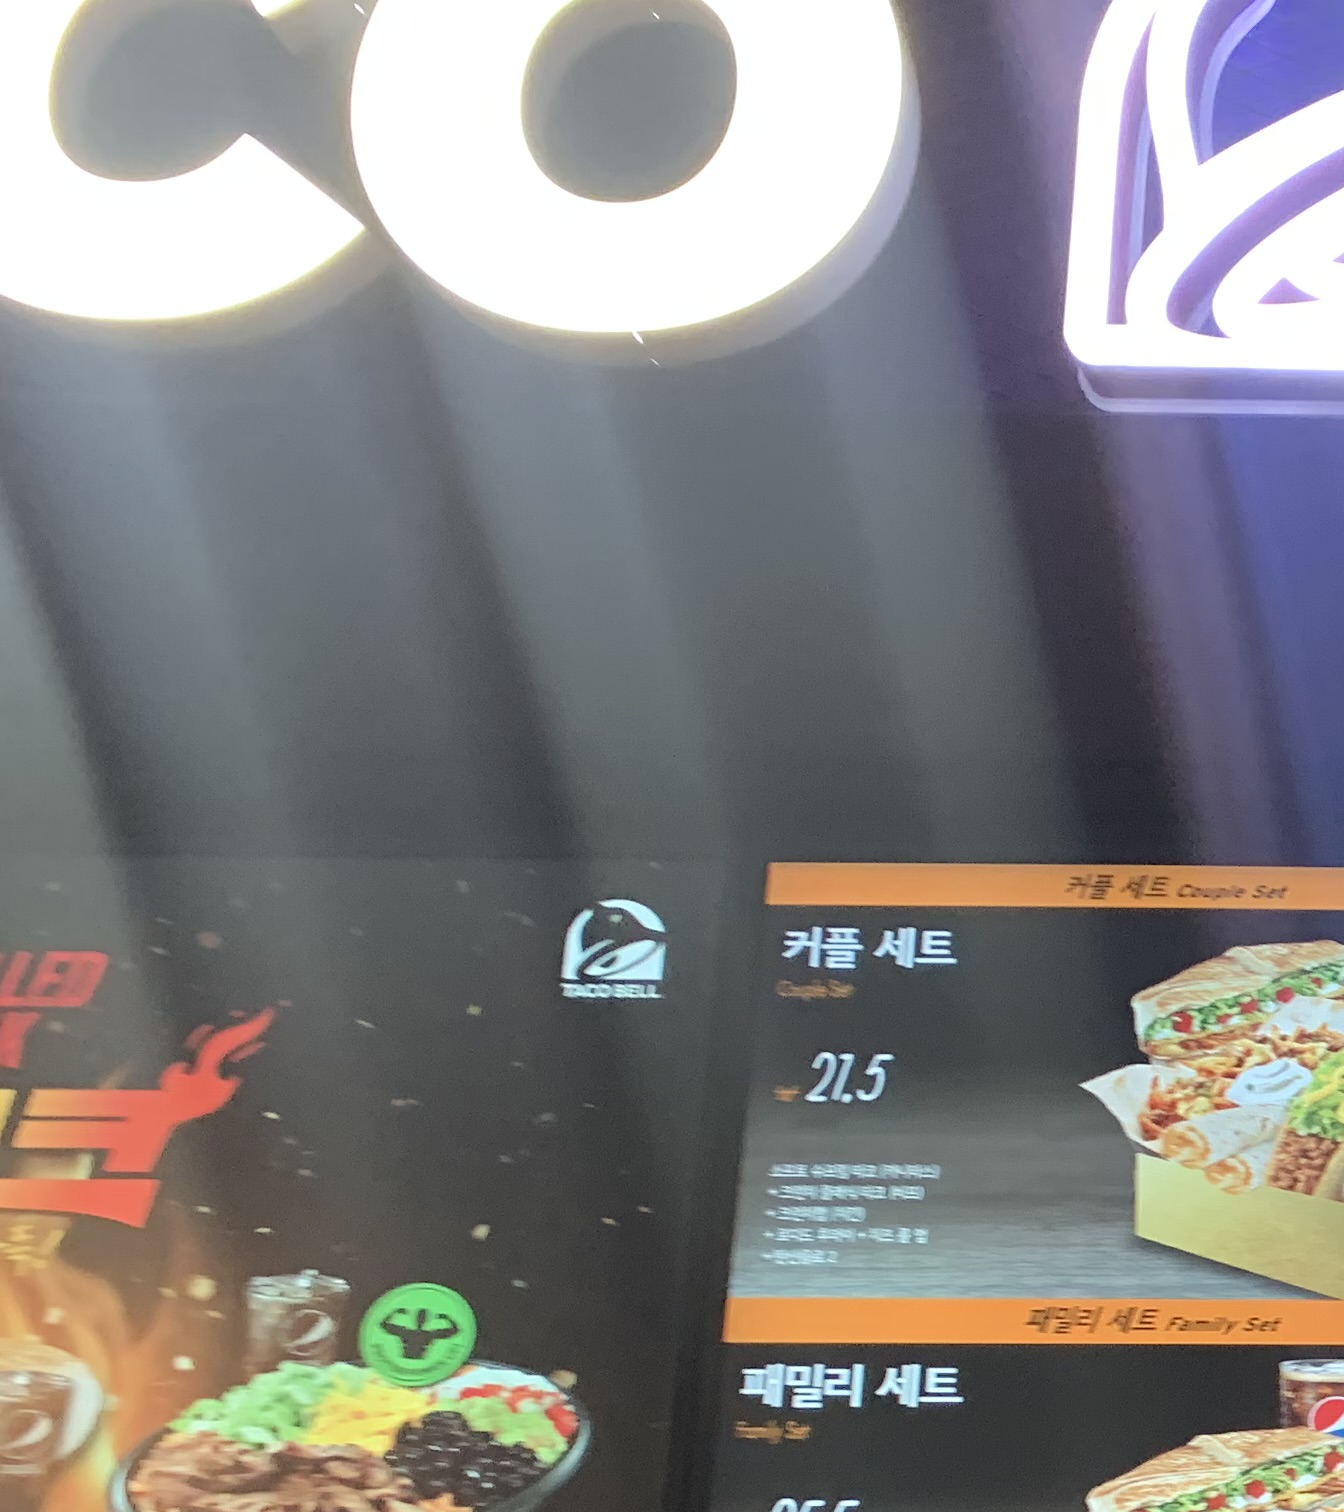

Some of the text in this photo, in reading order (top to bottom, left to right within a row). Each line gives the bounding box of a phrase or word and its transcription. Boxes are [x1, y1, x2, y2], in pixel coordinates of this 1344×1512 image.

[1064, 874, 1288, 900] 커플 세트 Couple Set
[781, 926, 958, 969] 커플 세트
[804, 1051, 895, 1103] 21.5
[1025, 1306, 1283, 1335] 패밀리 세트 Family Set
[739, 1363, 964, 1408] 패밀리 세트
